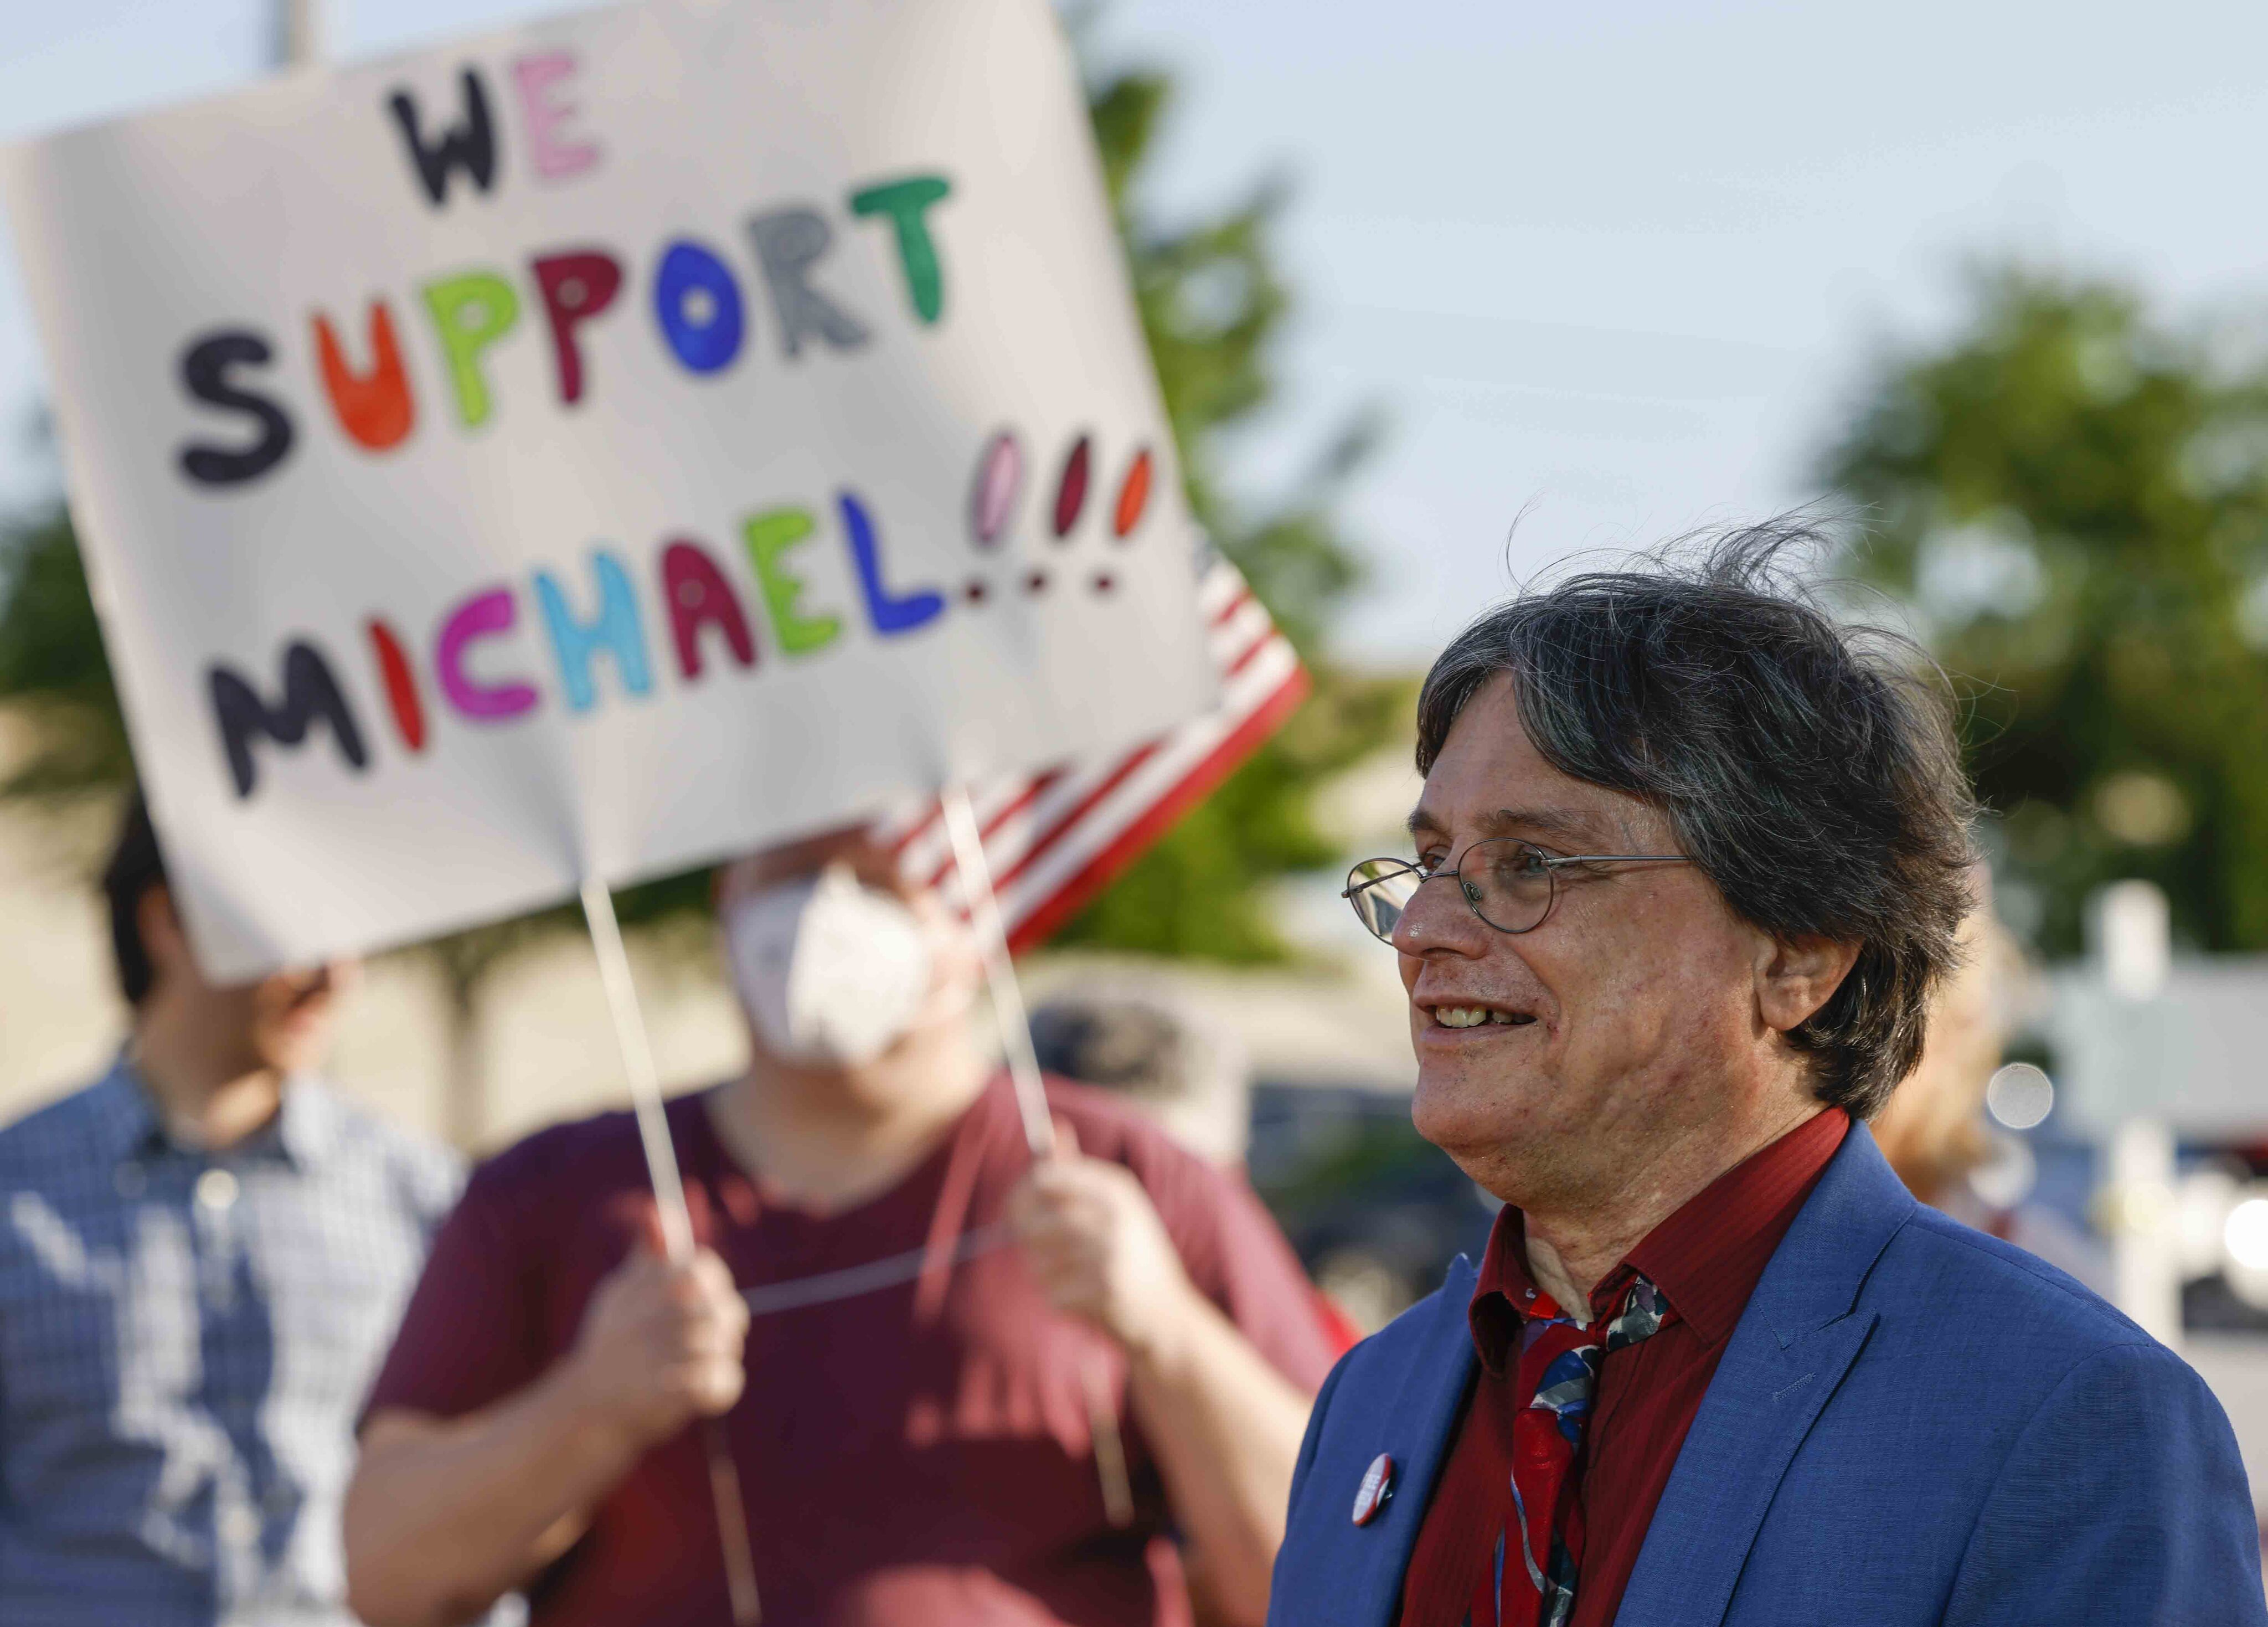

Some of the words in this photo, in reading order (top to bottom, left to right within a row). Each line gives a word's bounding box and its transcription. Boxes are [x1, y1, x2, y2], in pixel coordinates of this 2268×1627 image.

[386, 51, 600, 207] WE
[177, 175, 952, 490] SUPPORT
[204, 432, 1153, 800] MICHAEL!!!
